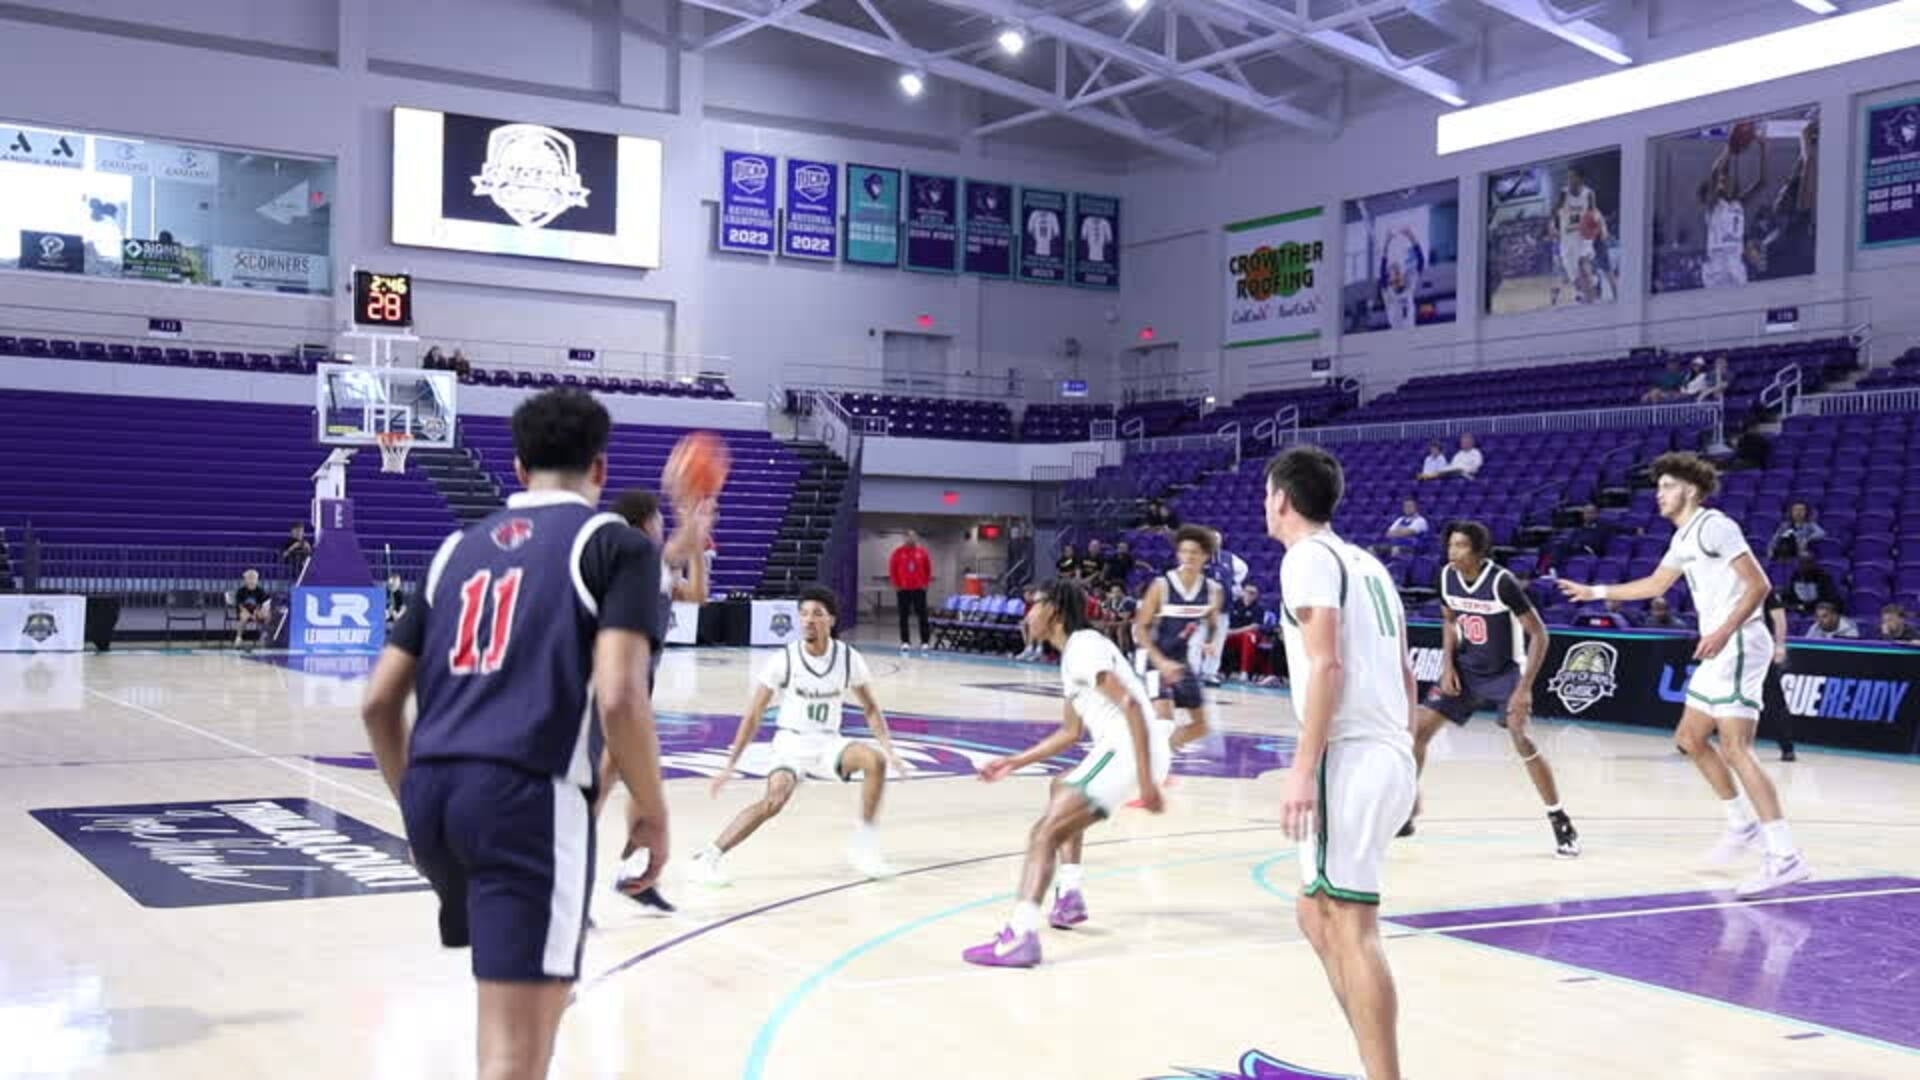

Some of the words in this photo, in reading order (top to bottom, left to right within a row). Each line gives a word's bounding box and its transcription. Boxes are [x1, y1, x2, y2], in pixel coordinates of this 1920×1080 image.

[729, 229, 769, 246] 2023
[791, 236, 831, 253] 2022
[1229, 241, 1324, 275] CROWTHER
[370, 275, 407, 295] 2:46
[1236, 268, 1314, 300] ROOFING
[368, 291, 401, 320] 28
[450, 567, 523, 675] 11
[1363, 575, 1397, 638] 11
[1457, 614, 1488, 645] 10
[807, 703, 829, 723] 10
[301, 844, 431, 888] COURT
